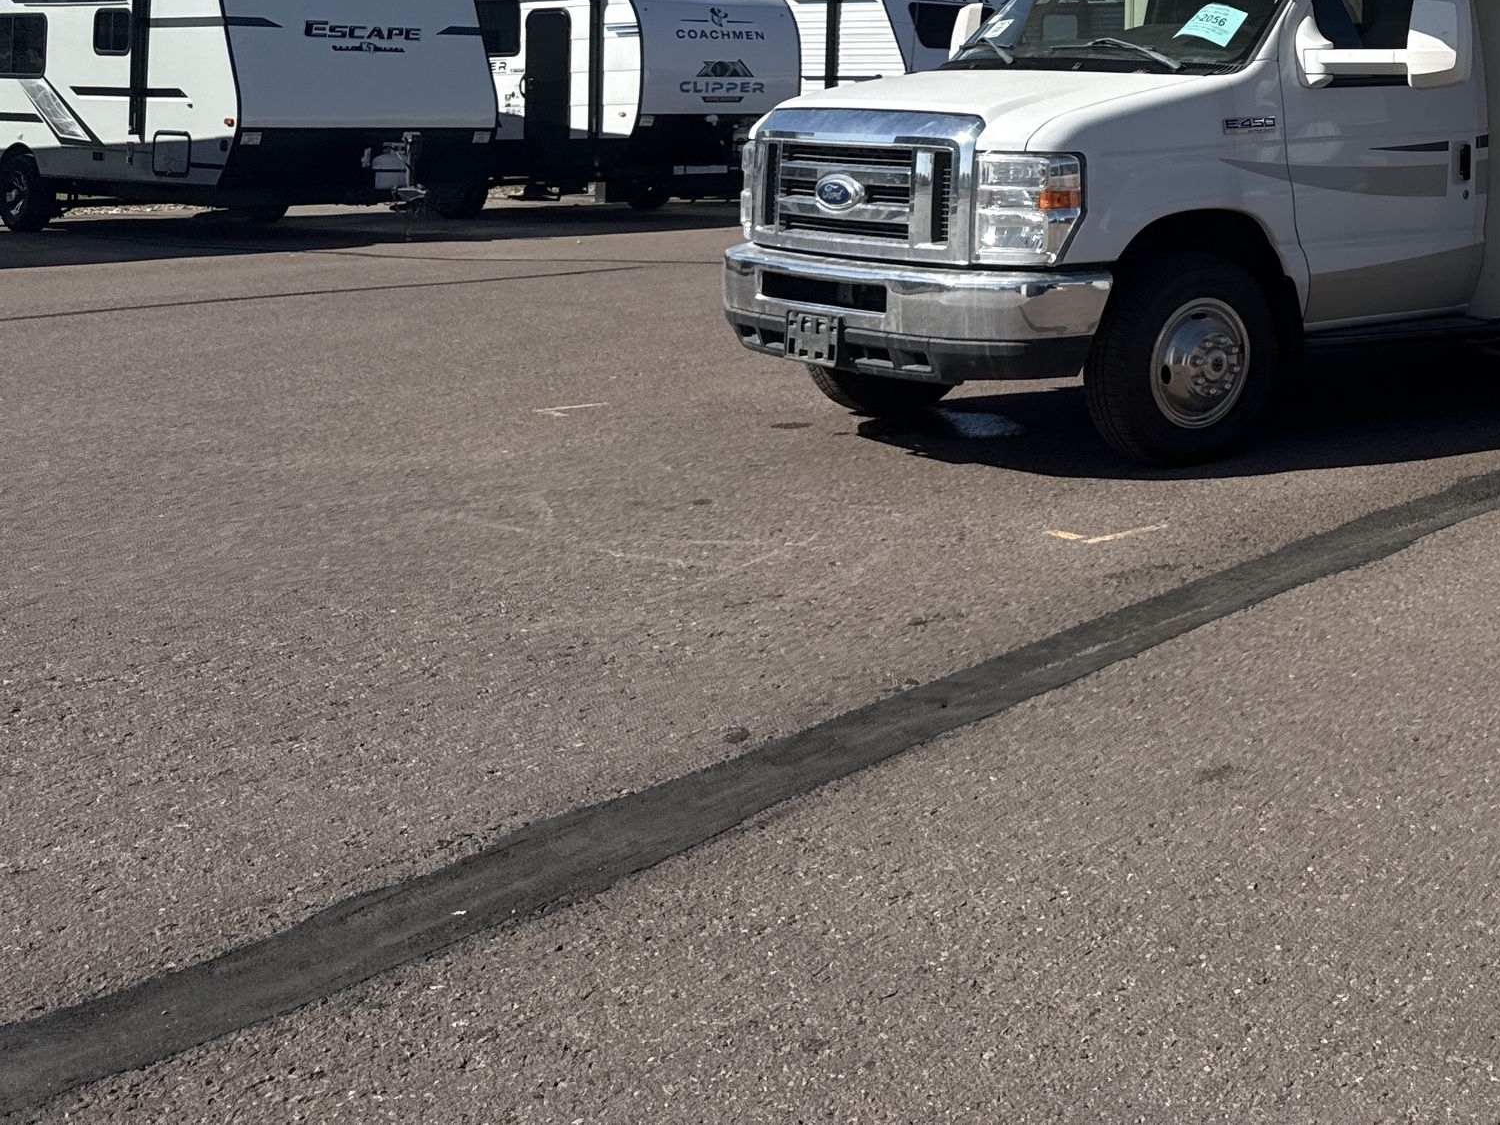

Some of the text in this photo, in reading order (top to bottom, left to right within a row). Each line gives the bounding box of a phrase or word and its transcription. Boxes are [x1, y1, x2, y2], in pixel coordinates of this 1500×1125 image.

[1199, 13, 1228, 27] 2056
[304, 20, 421, 40] ESCAPE
[676, 29, 765, 40] COACHMEN
[679, 81, 765, 94] CLIPPER
